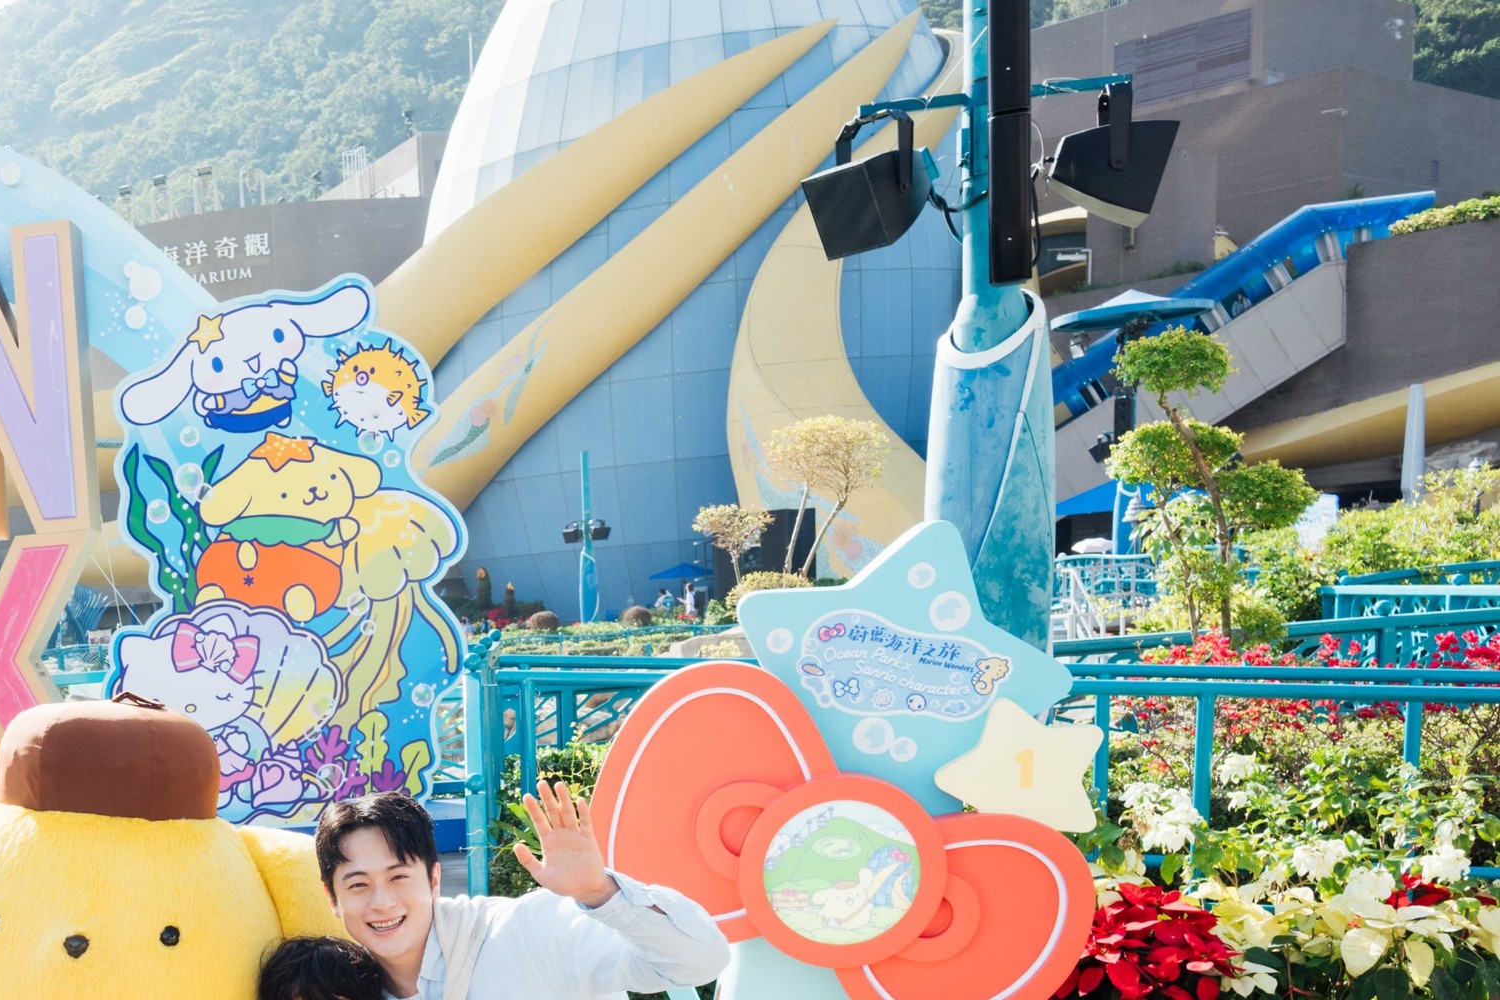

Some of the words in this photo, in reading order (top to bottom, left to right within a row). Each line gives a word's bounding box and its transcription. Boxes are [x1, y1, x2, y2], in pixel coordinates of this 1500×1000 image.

[823, 647, 867, 663] Ocean
[871, 648, 903, 671] Park
[847, 624, 962, 661] 蔚藍海洋之旅
[852, 660, 896, 683] Sanrio
[899, 675, 971, 696] characters
[918, 656, 943, 667] Marine
[943, 661, 975, 674] Wonders
[1015, 748, 1035, 789] 1
